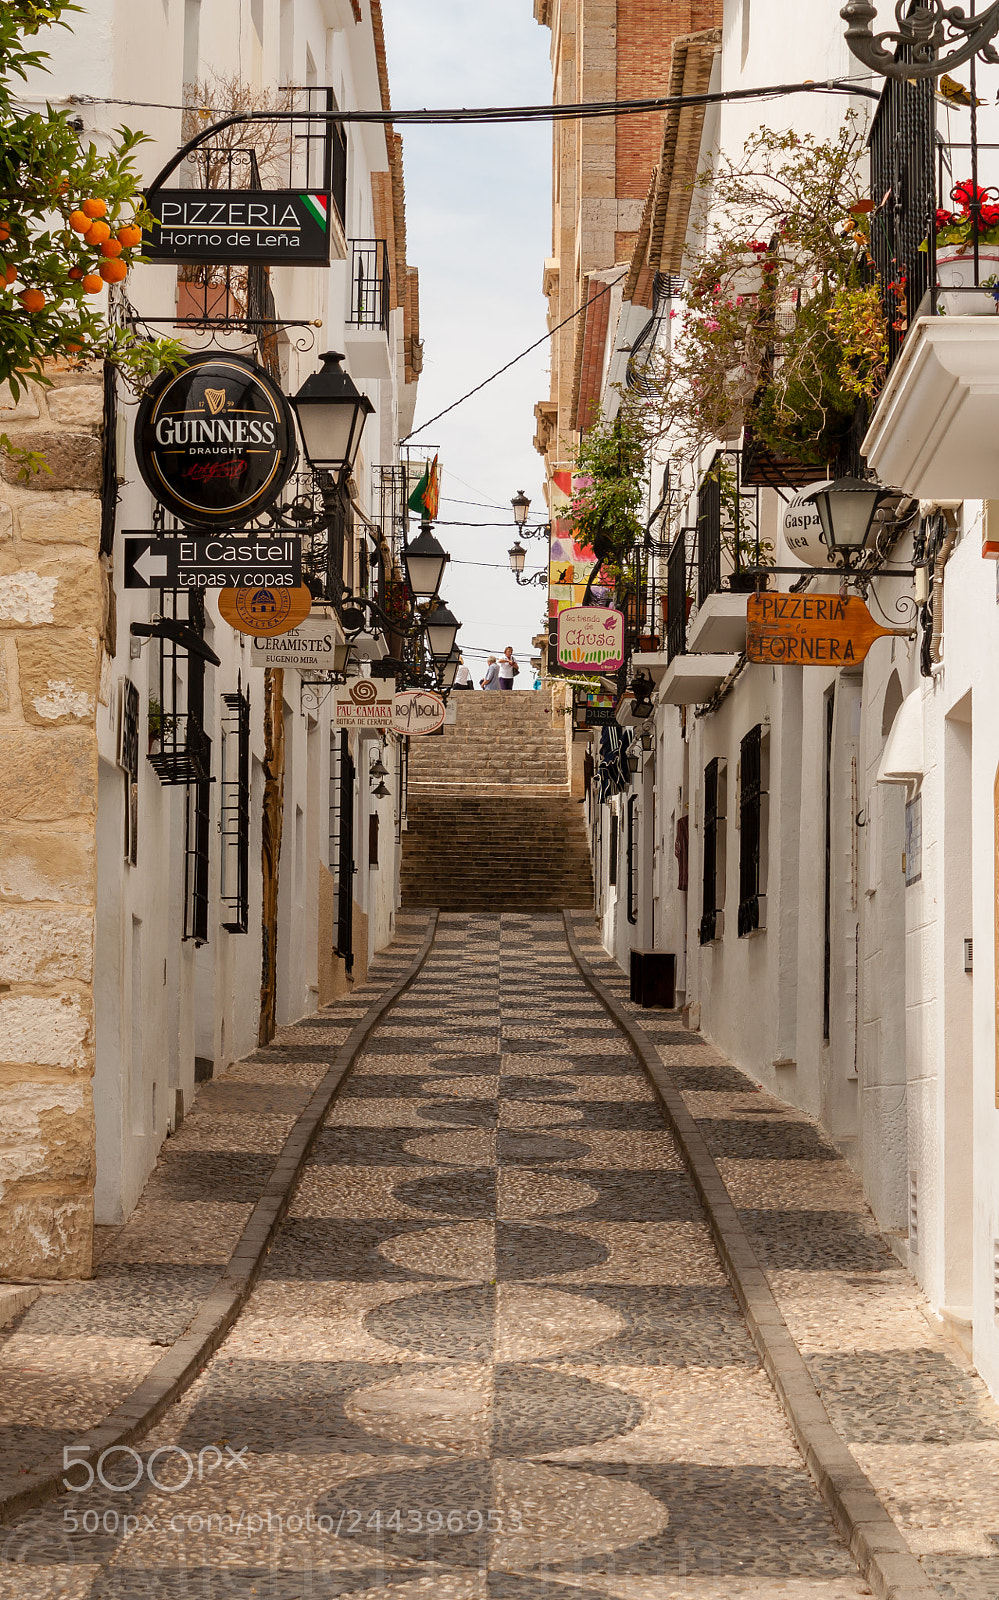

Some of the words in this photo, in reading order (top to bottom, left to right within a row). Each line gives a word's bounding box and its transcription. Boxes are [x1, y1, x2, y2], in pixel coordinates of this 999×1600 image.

[161, 202, 301, 225] PIZZERIA
[160, 231, 222, 246] Horno
[226, 232, 251, 246] de
[256, 232, 301, 247] Leña
[155, 417, 275, 445] GUINNESS
[189, 447, 244, 455] DRAUGHT
[179, 542, 197, 561] El
[205, 541, 293, 561] Castell
[177, 571, 226, 588] tapas
[230, 574, 241, 588] y
[244, 573, 294, 588] copas
[762, 598, 845, 620] PIZZERIA
[566, 629, 616, 646] Chusa
[758, 637, 855, 660] FORNERA
[266, 655, 299, 664] EUGENIO
[300, 656, 318, 664] MIRA
